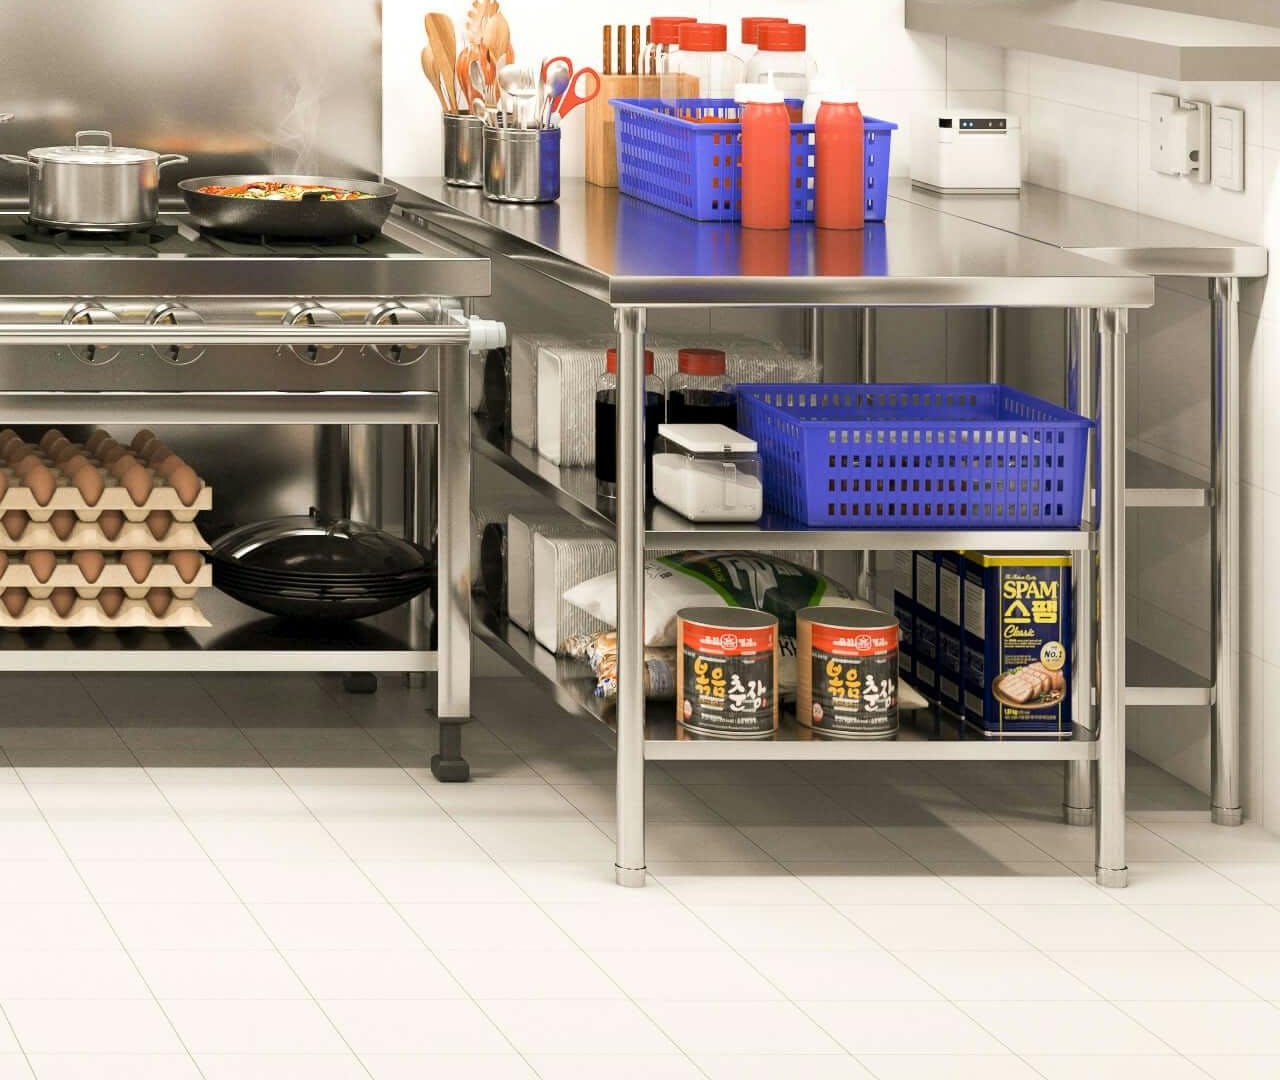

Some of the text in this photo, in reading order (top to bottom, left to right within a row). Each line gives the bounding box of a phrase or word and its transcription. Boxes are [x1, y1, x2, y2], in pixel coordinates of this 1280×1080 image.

[1003, 580, 1058, 599] SPAM
[1003, 600, 1058, 623] 스팸
[694, 656, 767, 712] 볶음 춘장
[826, 658, 895, 712] 볶음 춘장
